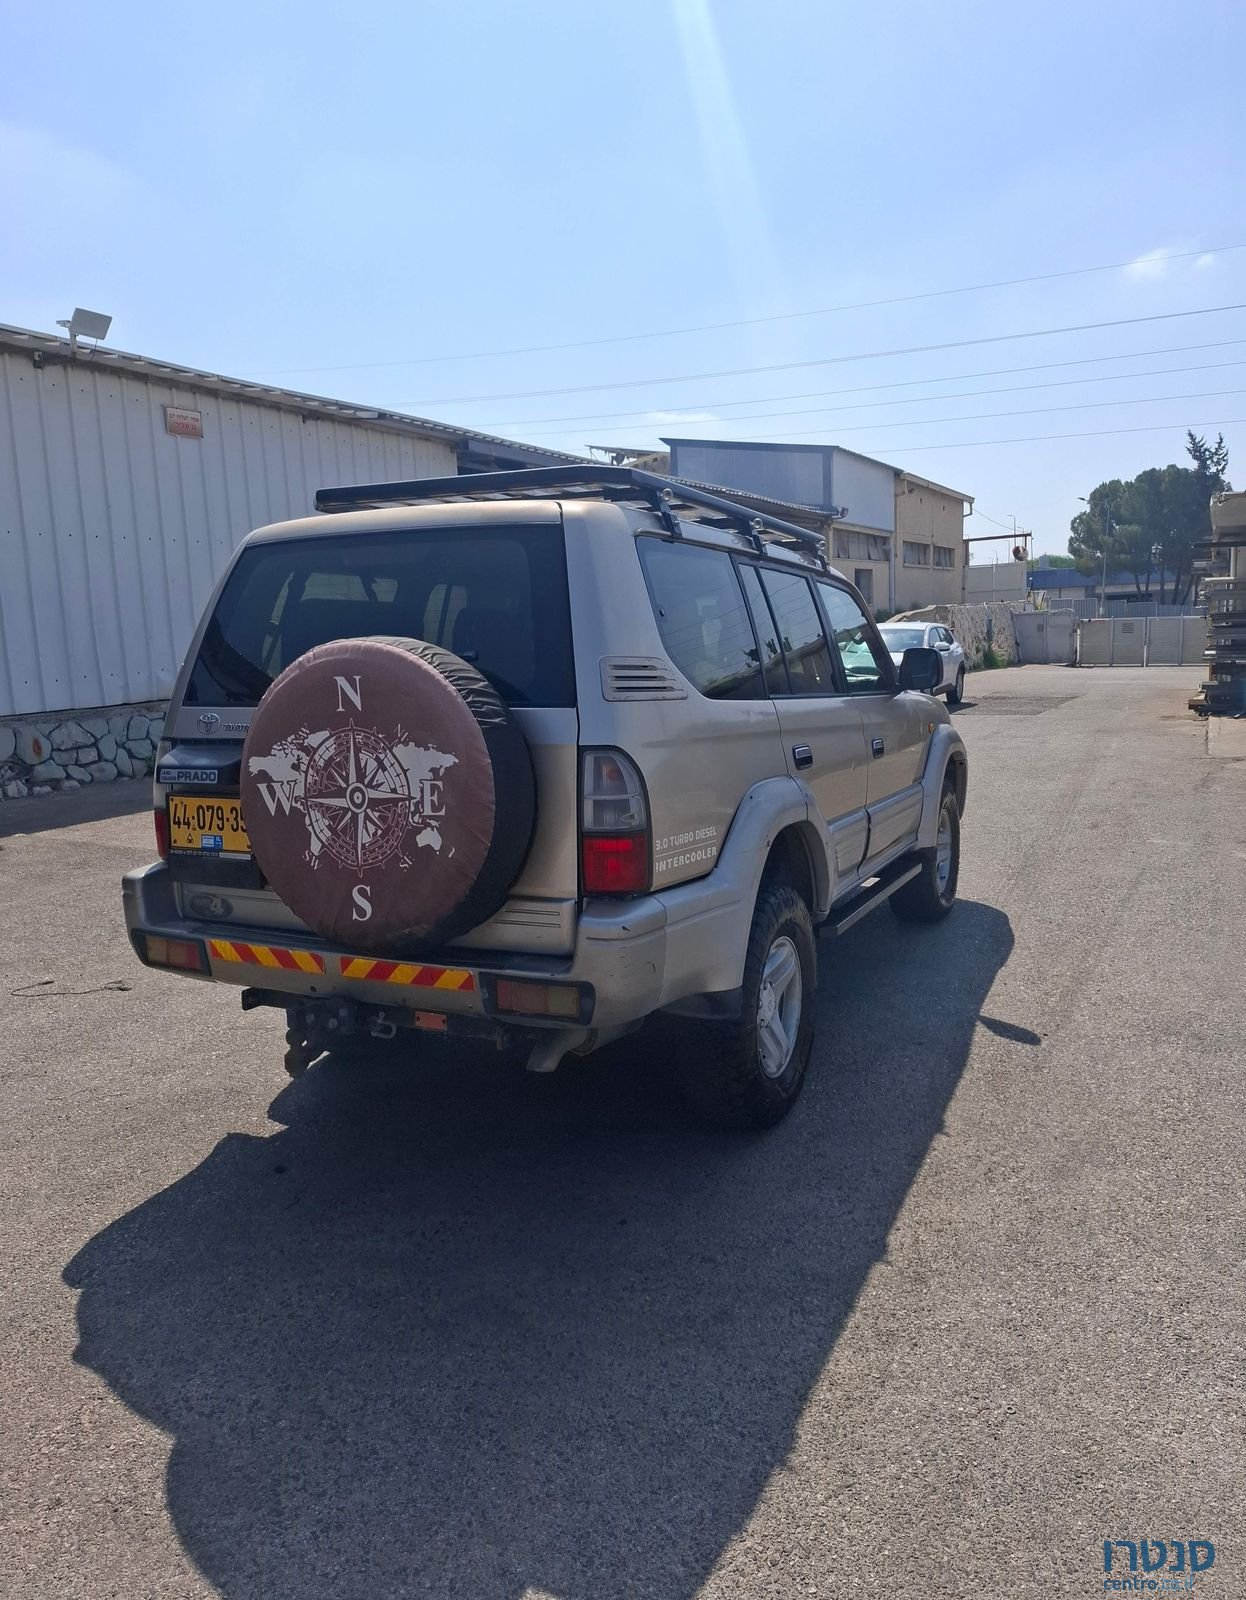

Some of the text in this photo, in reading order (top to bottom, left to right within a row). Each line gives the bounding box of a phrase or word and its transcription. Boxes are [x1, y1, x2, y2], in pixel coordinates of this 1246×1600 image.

[334, 675, 362, 712] N
[177, 771, 217, 782] PRADO
[257, 778, 297, 816] W
[421, 779, 446, 816] E
[655, 826, 717, 850] 3.0 TURBO DIESEL
[655, 846, 717, 873] INTERCOOLER
[352, 884, 373, 921] S
